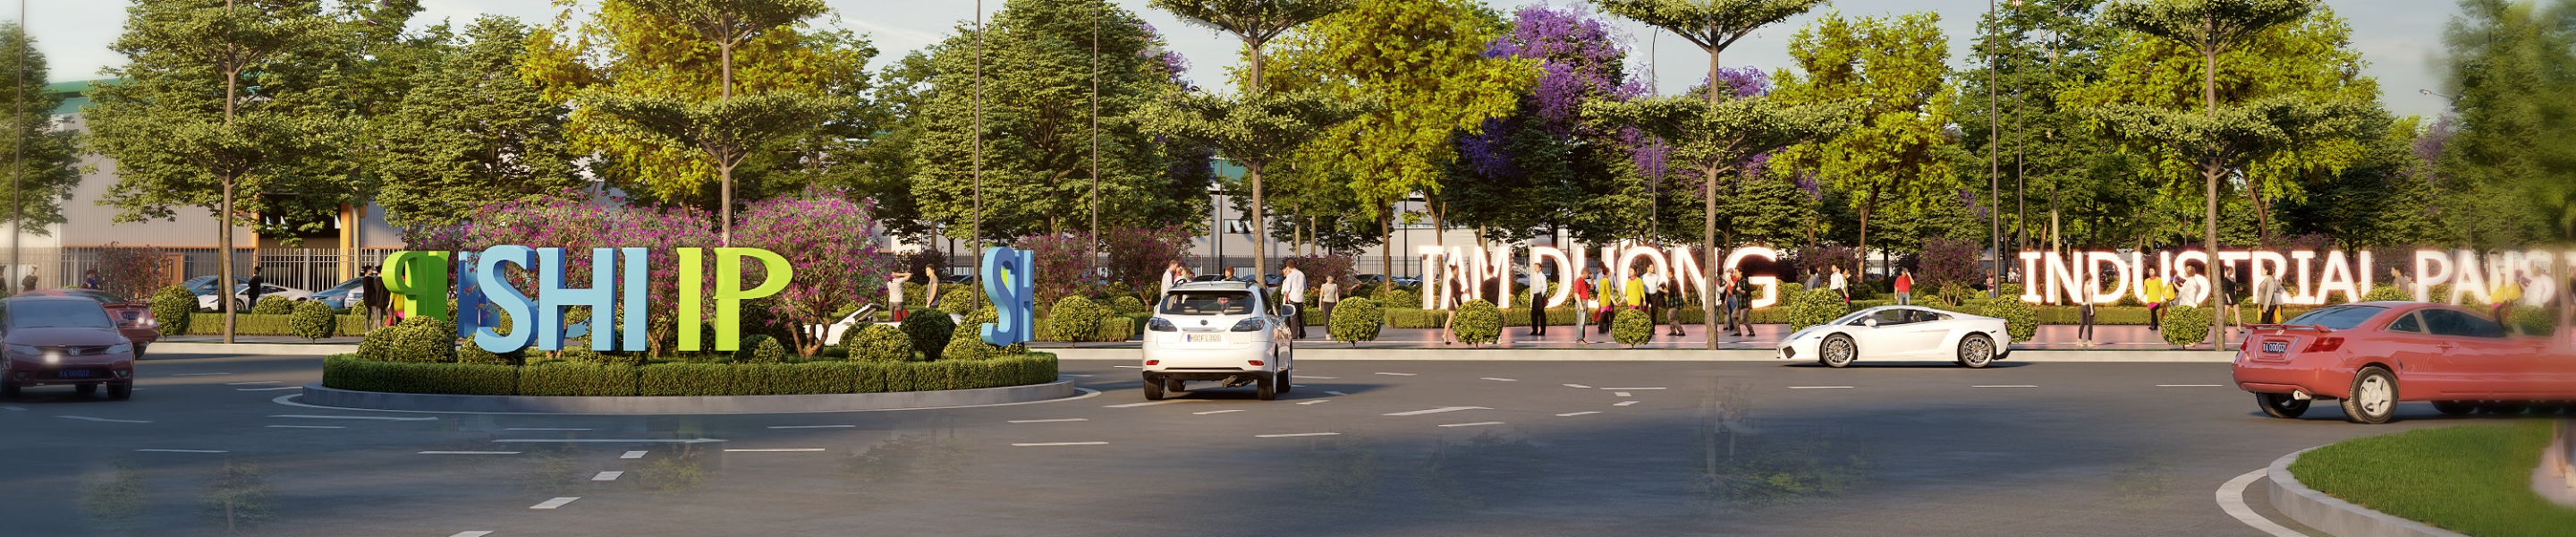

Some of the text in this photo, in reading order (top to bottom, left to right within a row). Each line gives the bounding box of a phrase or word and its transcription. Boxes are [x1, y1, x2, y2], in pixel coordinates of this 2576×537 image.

[474, 245, 649, 354] SHI
[677, 247, 793, 352] IP
[1418, 245, 1512, 310] TAM
